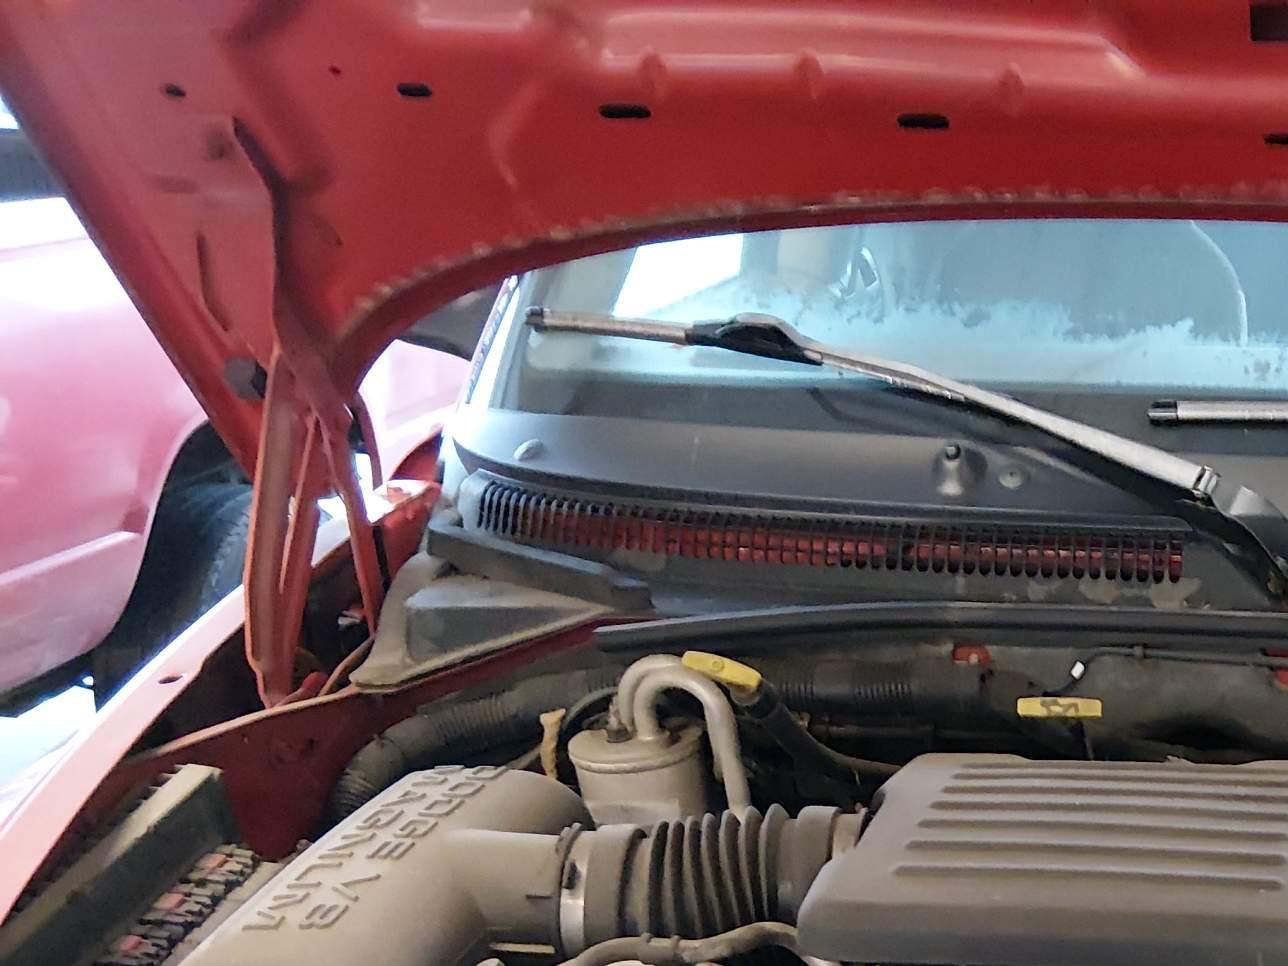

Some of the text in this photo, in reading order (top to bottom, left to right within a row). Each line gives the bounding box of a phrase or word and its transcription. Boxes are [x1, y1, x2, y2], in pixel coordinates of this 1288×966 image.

[241, 764, 467, 931] MAGNUM
[299, 765, 508, 931] DODGE V8
